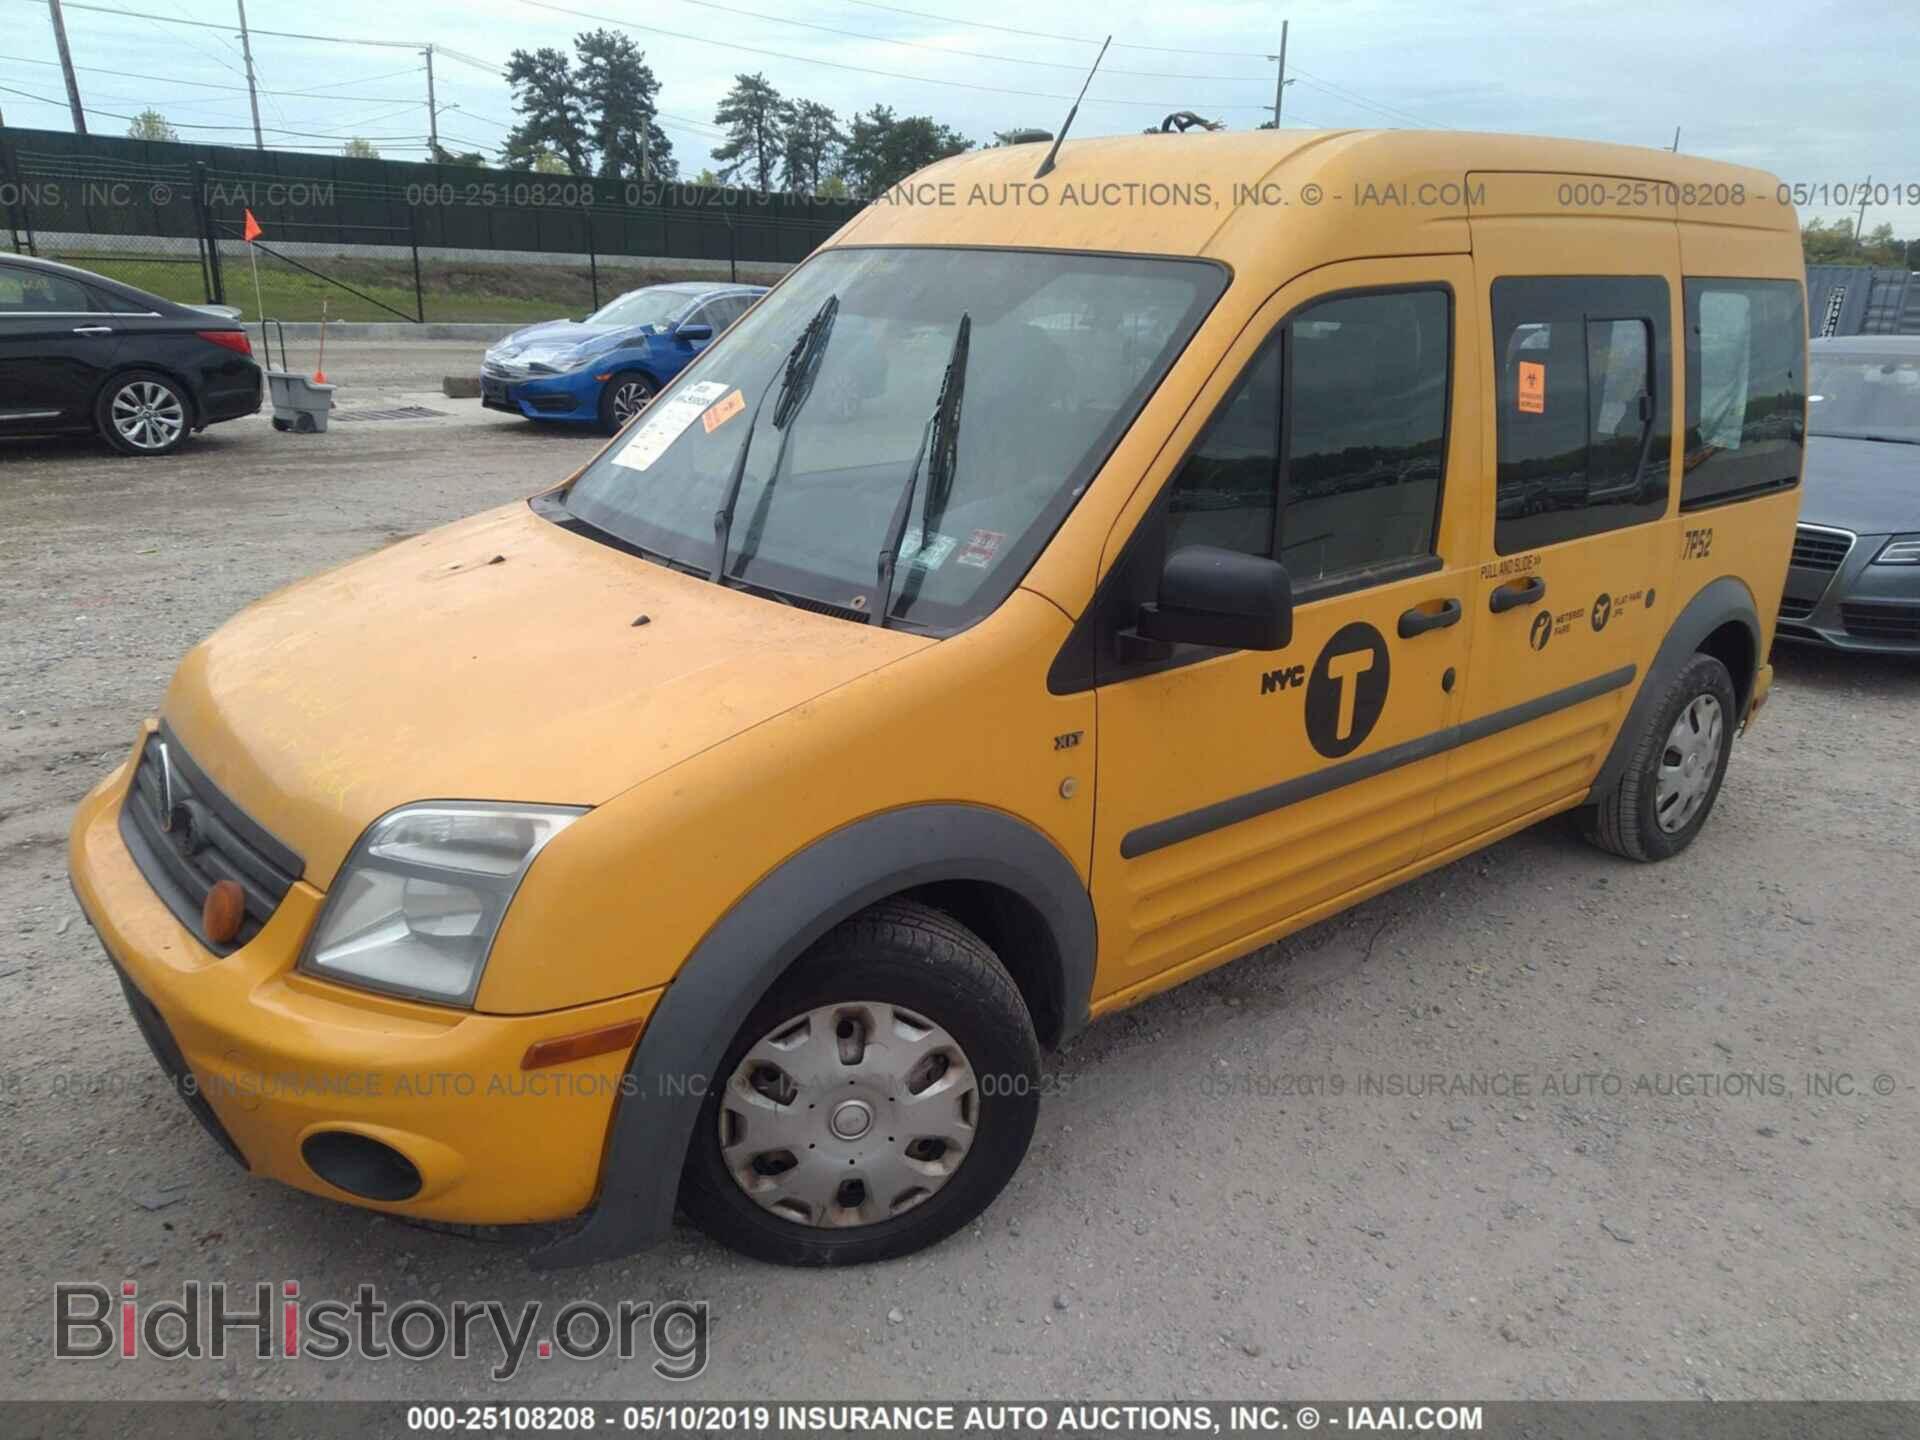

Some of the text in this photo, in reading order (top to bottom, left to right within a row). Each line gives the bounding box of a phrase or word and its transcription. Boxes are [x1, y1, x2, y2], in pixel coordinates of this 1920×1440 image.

[1683, 528, 1713, 560] 7P52
[1514, 554, 1533, 574] SLIDE
[1260, 664, 1305, 695] NYC
[1328, 648, 1375, 741] T
